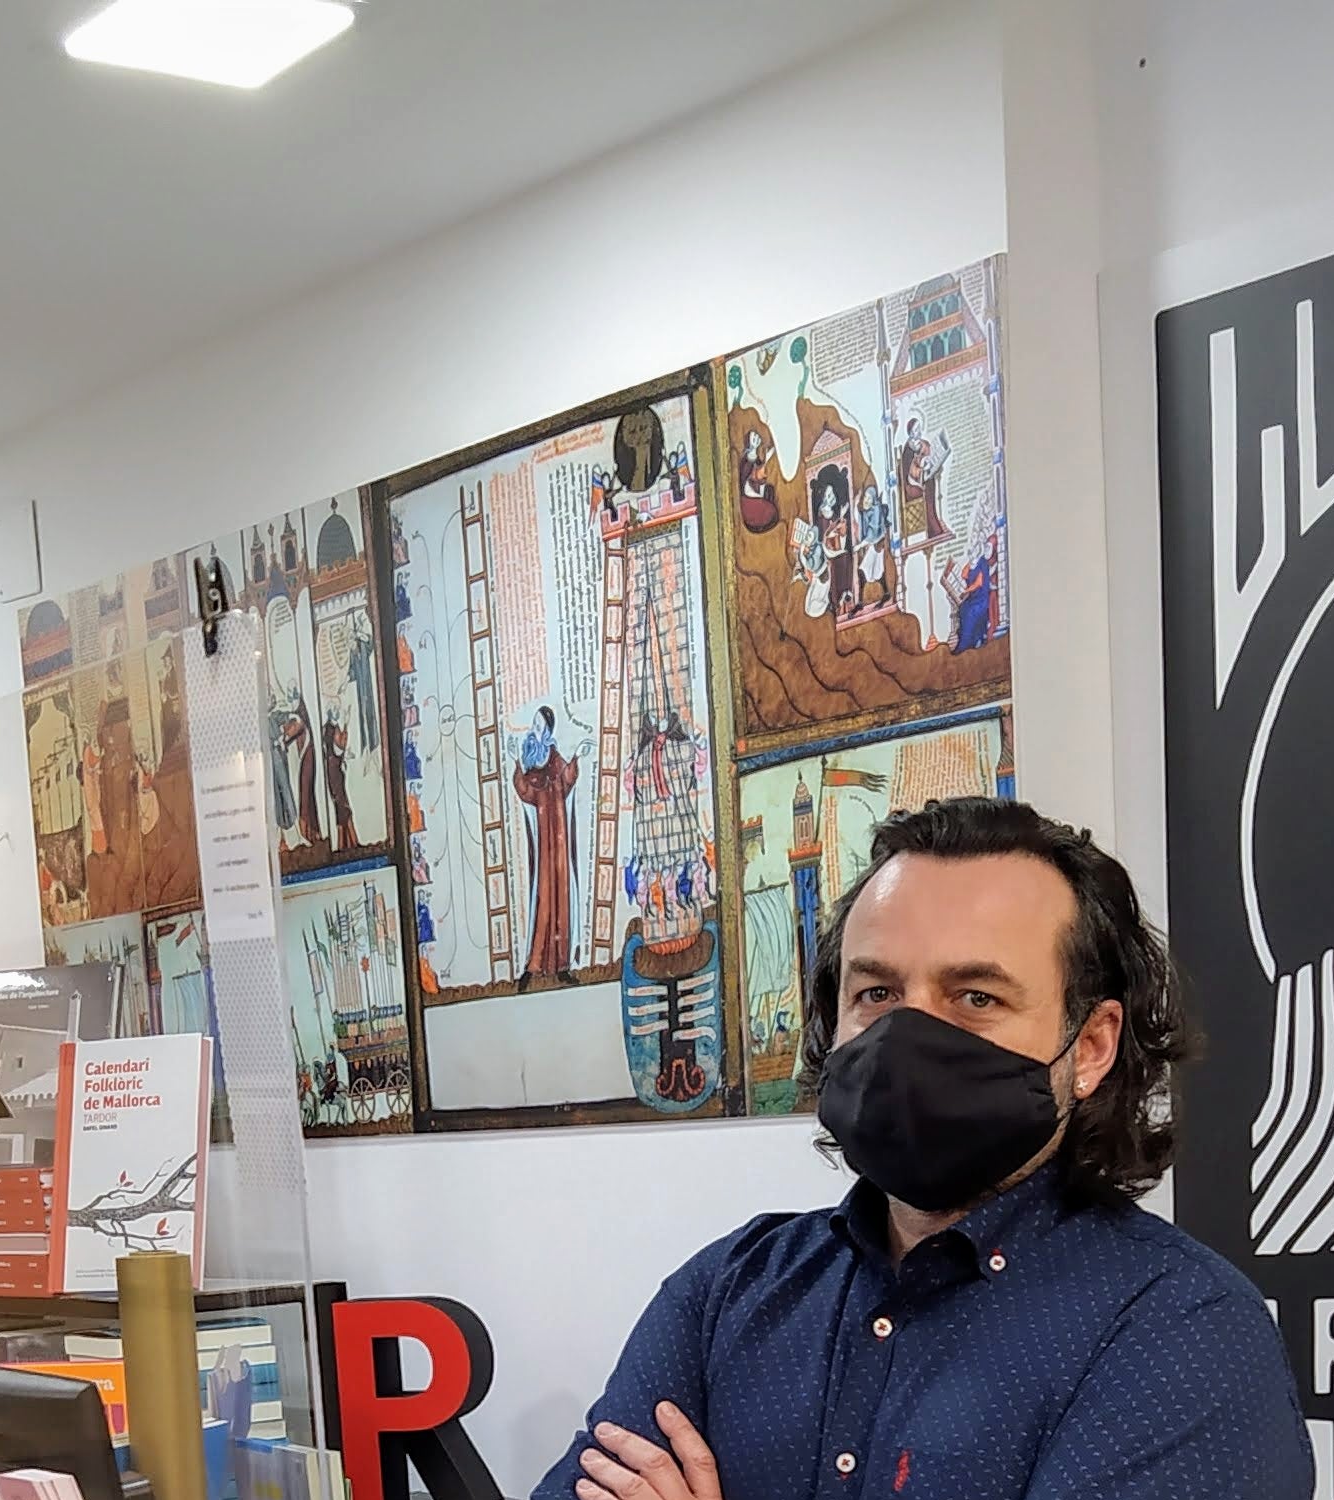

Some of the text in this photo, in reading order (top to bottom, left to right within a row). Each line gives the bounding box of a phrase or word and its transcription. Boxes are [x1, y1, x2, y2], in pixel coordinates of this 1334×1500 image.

[85, 1057, 150, 1076] Calendari
[84, 1076, 143, 1093] Folklòric
[83, 1093, 161, 1110] de Mallorca
[83, 1112, 118, 1124] TARDOR
